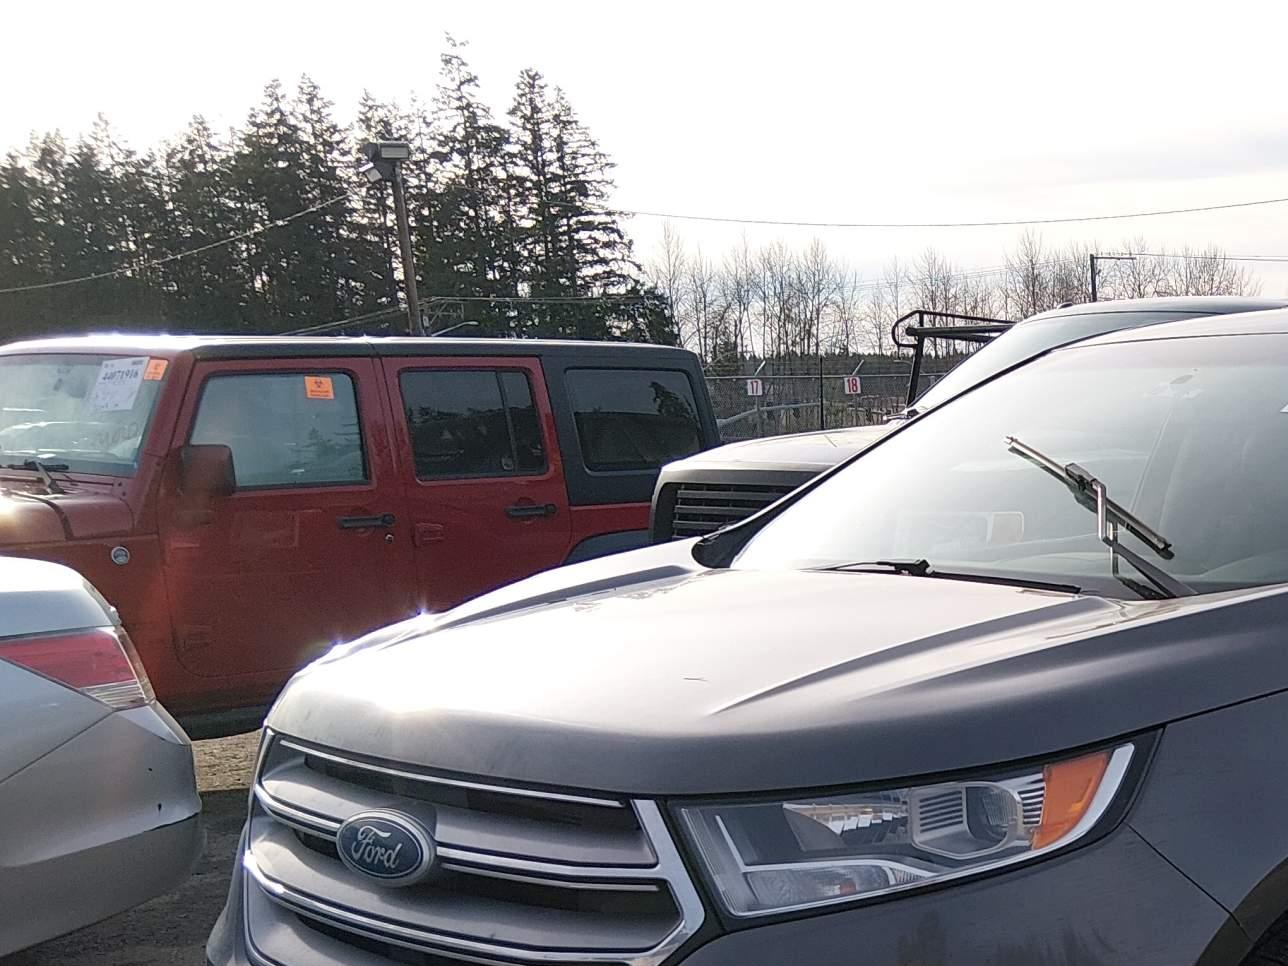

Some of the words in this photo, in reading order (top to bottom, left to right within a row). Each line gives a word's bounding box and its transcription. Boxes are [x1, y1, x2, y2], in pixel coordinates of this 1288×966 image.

[751, 380, 759, 394] 17
[847, 377, 858, 393] 18
[351, 825, 402, 868] Ford
